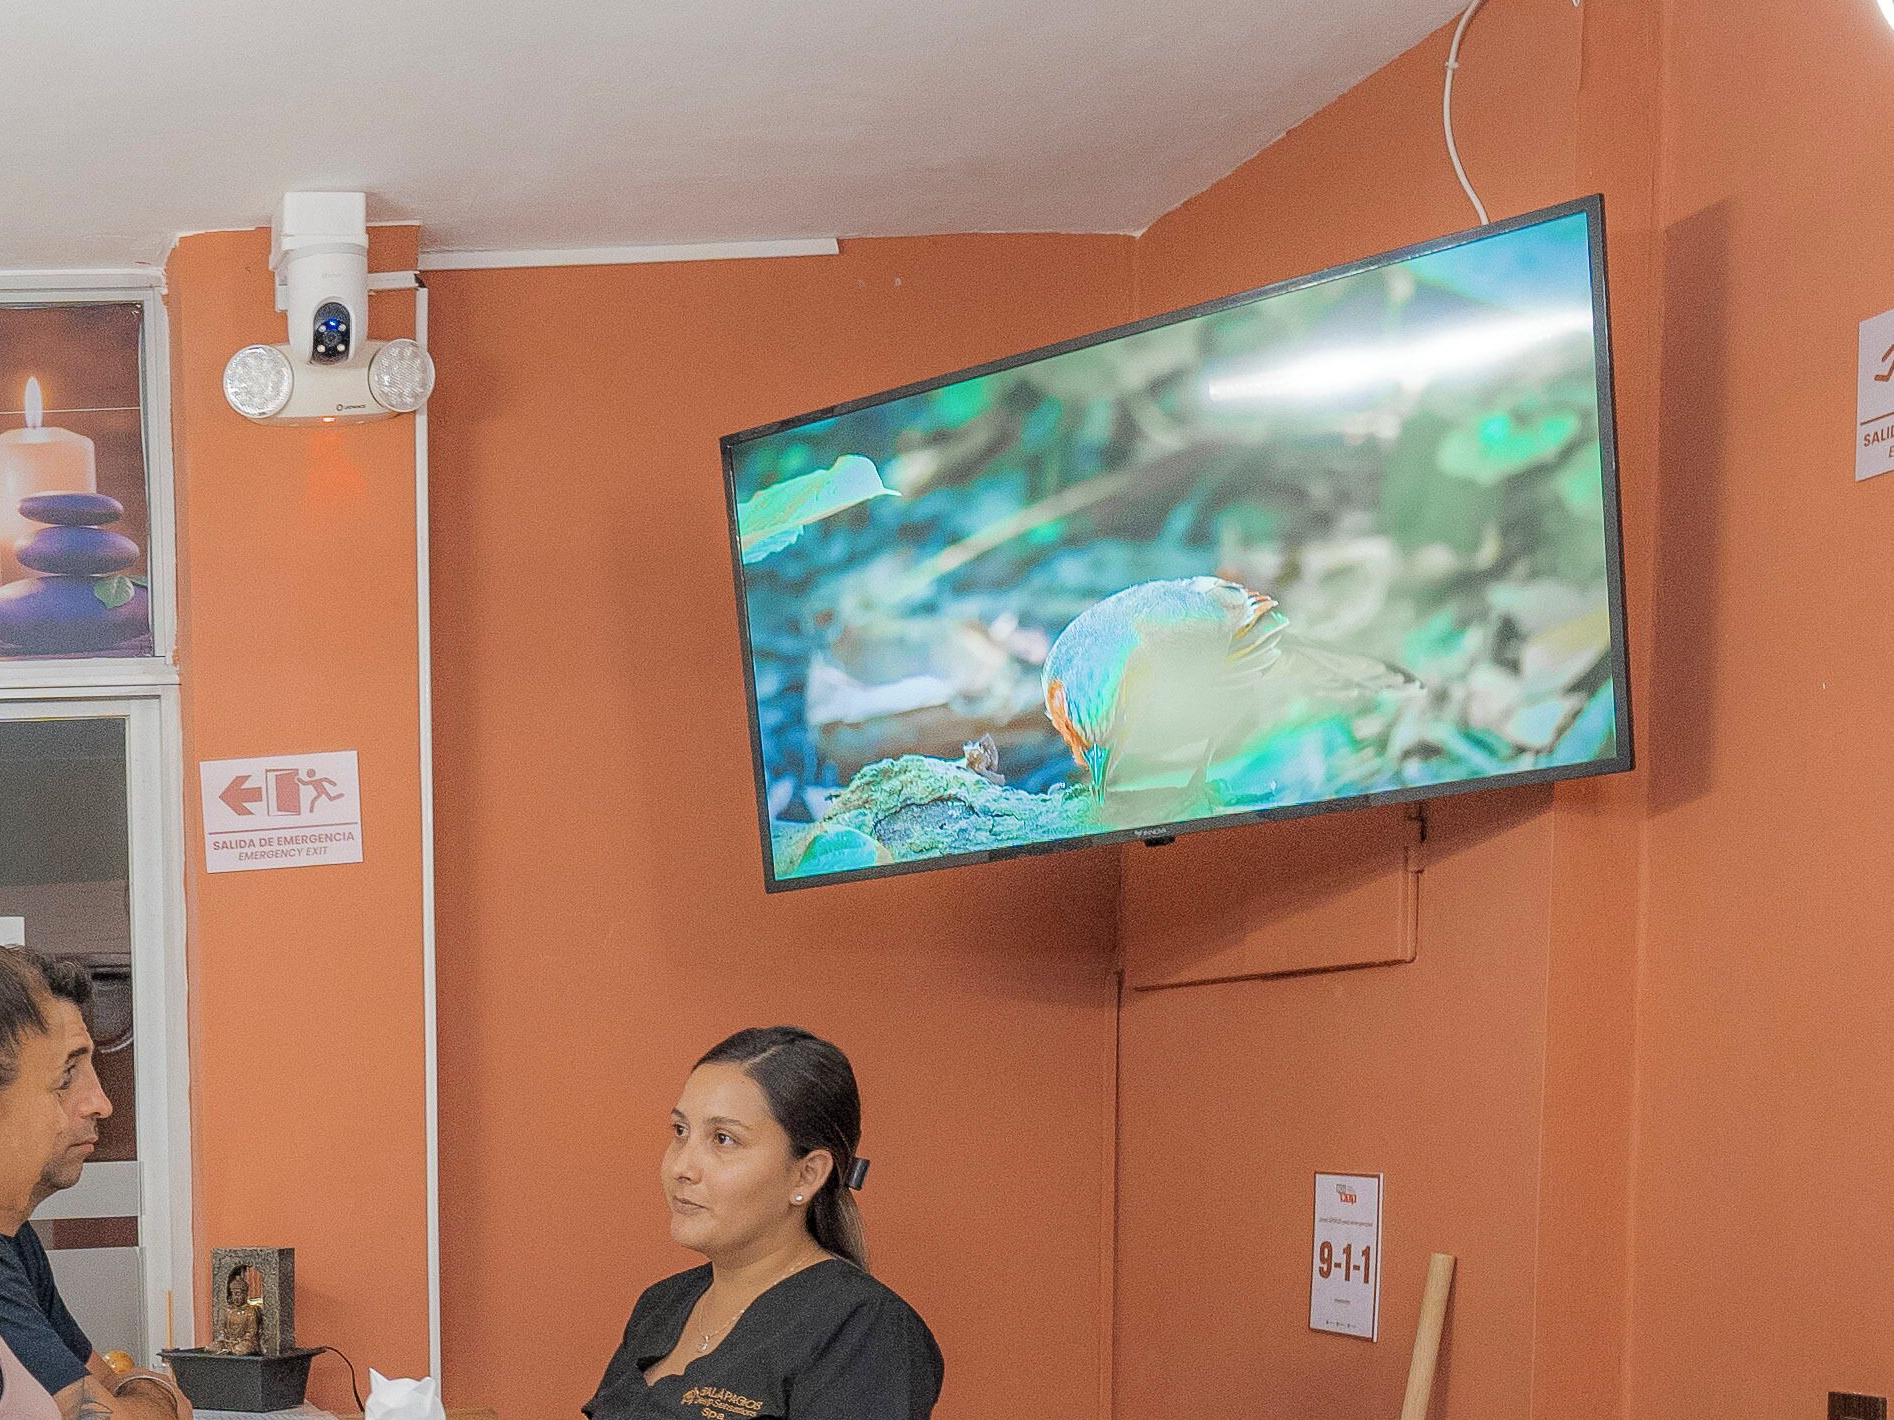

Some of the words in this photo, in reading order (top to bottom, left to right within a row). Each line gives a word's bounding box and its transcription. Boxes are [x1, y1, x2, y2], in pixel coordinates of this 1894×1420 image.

[212, 839, 256, 851] SALIDA
[259, 838, 274, 847] DE
[277, 831, 355, 847] EMERGENCIA
[238, 848, 303, 861] EMERGENCY
[306, 846, 328, 856] EXIT
[1318, 1240, 1371, 1285] 9-1-1
